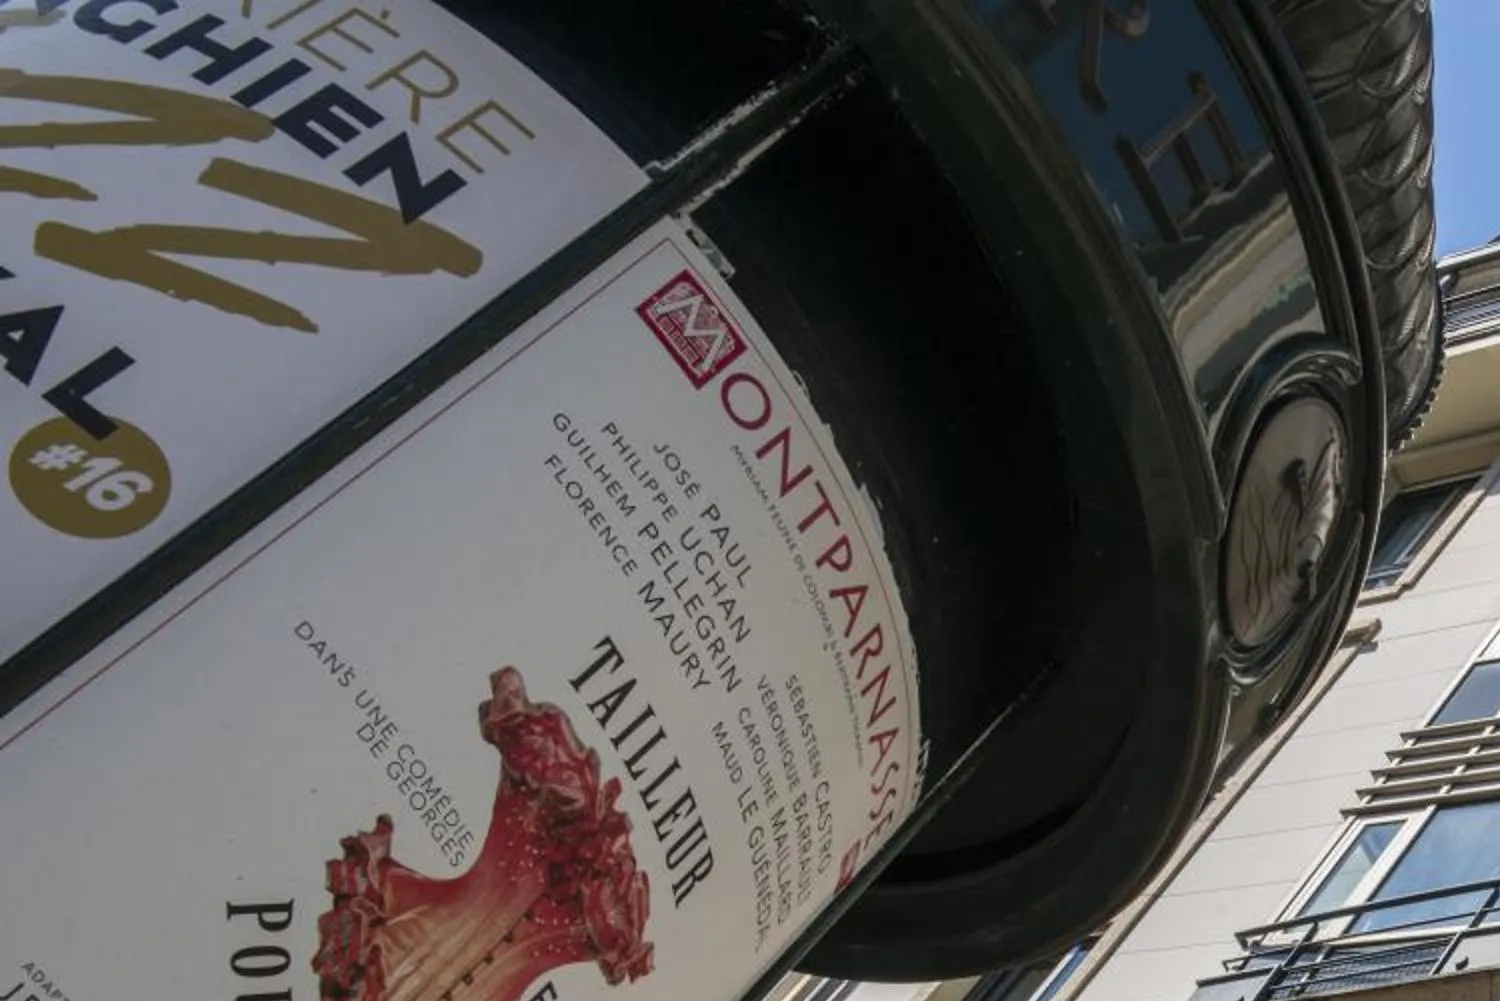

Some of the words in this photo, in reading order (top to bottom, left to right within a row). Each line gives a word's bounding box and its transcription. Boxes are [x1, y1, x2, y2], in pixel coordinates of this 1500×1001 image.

[35, 0, 467, 225] GHIEN
[242, 0, 536, 175] IÈRE
[0, 265, 136, 440] AL
[28, 444, 154, 511] #16
[553, 412, 636, 517] GUILHEM
[637, 521, 743, 693] PELLEGRIN
[601, 422, 679, 522] PHILIPPE
[680, 527, 751, 643] UCHAN
[653, 442, 700, 500] JOSÉ
[700, 506, 749, 588] PAUL
[544, 453, 639, 577] FLORENCE
[638, 581, 711, 690] MAURY
[294, 620, 355, 688] DANS
[354, 690, 399, 740] UNE
[738, 706, 778, 810] CAROLINE
[756, 674, 800, 794] VÉRONIQUE
[355, 724, 384, 759] DE
[386, 761, 466, 867] GEORGES
[568, 635, 715, 908] TAILLEUR
[712, 721, 743, 784] MAUD
[737, 789, 758, 823] LE
